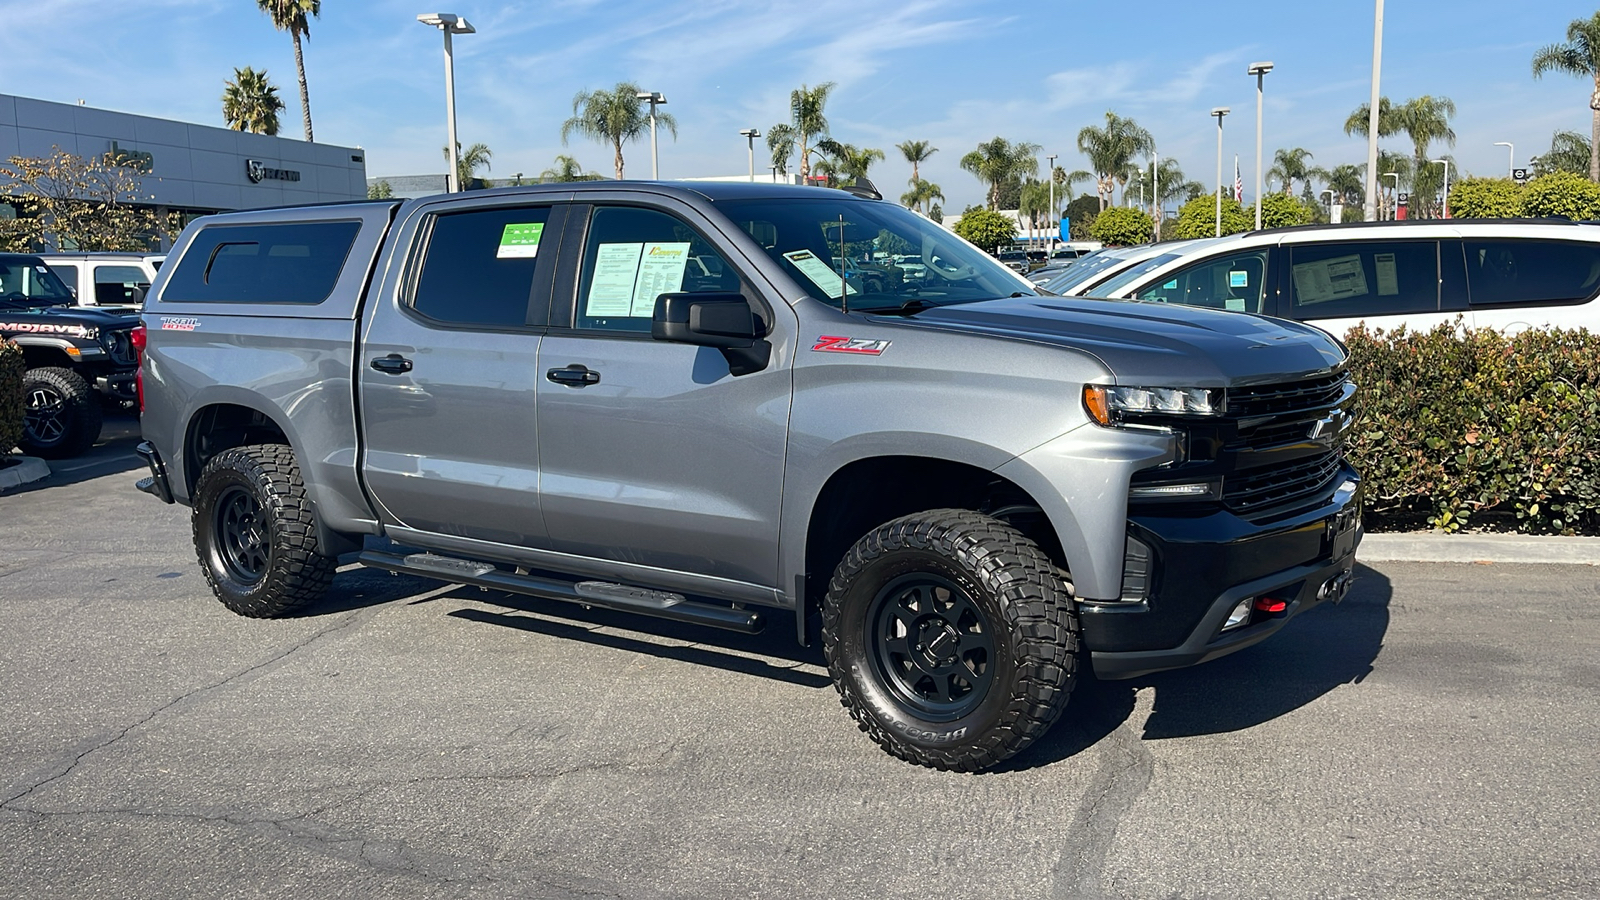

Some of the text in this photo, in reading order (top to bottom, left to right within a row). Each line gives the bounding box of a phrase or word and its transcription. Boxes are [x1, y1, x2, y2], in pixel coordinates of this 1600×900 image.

[264, 168, 300, 181] RAM
[160, 316, 201, 326] TRAIL
[0, 322, 82, 334] MOJAVE
[811, 335, 892, 356] Z71
